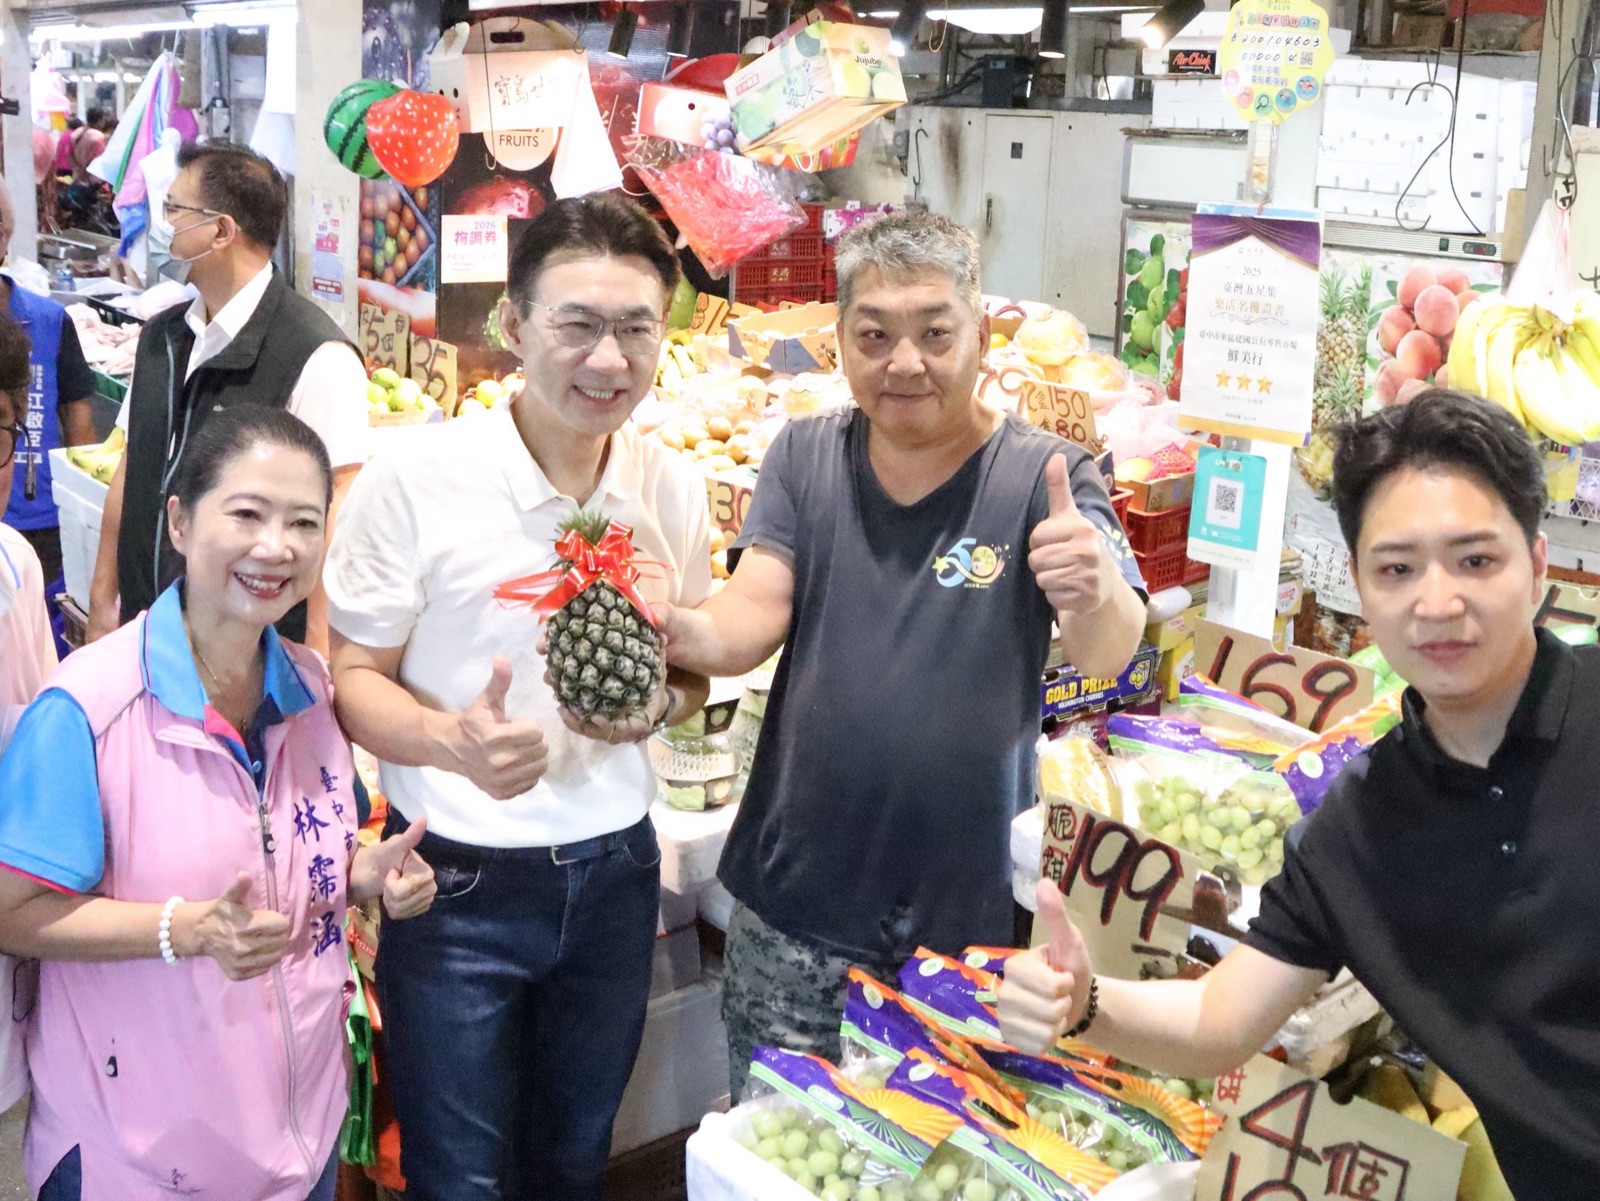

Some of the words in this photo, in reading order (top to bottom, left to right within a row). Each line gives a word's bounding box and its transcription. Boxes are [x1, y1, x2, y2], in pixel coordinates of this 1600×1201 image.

[855, 55, 882, 67] Jujube
[499, 134, 539, 148] FRUITS
[474, 221, 496, 230] 2026
[1242, 266, 1262, 277] 2025
[1223, 281, 1277, 298] 臺灣五星集
[1227, 348, 1264, 366] 鮮美行
[1045, 681, 1078, 705] GOLD
[1080, 677, 1119, 696] PRIZE
[1207, 634, 1359, 734] 169
[1058, 696, 1085, 709] WASHINGTON
[1085, 691, 1104, 702] CHERRIES
[319, 765, 355, 851] 臺中市
[1058, 811, 1185, 943] 199
